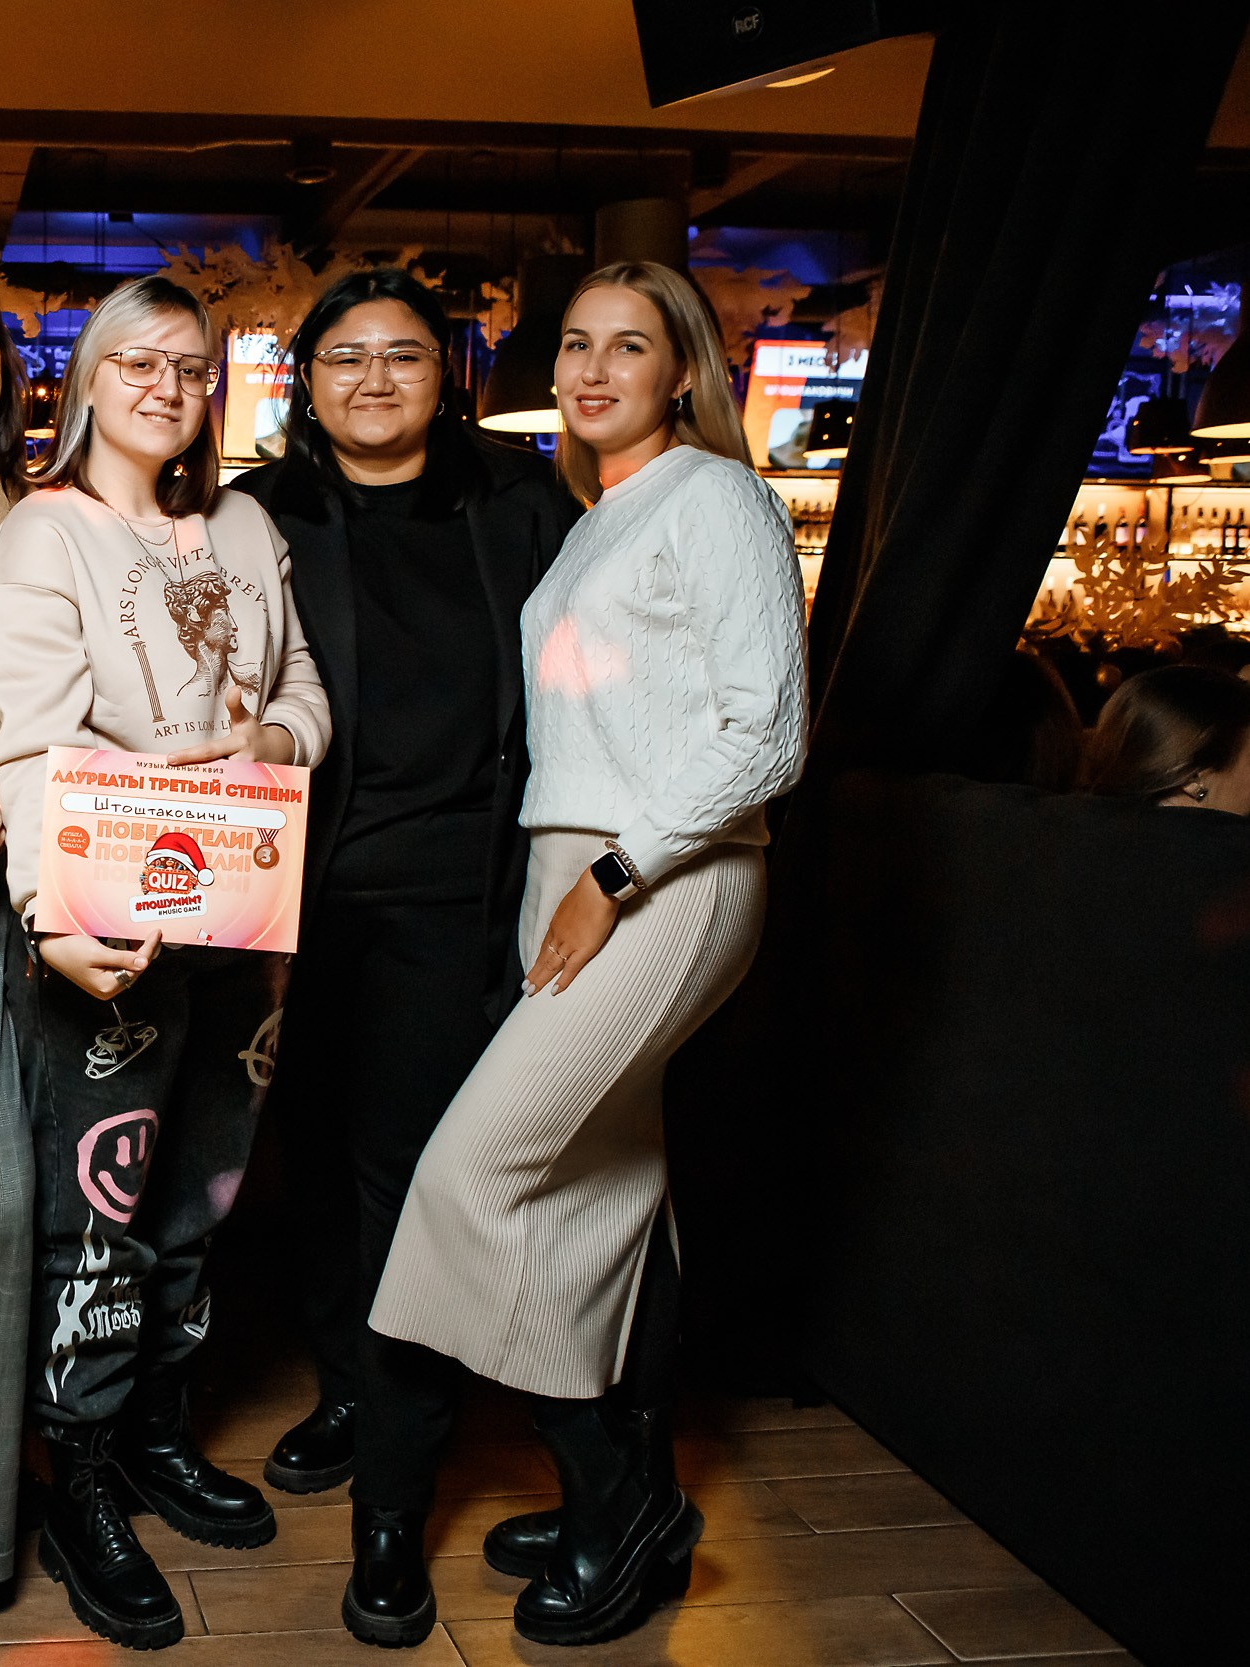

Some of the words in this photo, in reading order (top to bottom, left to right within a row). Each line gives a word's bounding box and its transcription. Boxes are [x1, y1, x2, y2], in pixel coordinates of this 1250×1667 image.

[166, 547, 217, 569] VITA
[121, 555, 167, 595] LONGA
[219, 566, 268, 613] BREV
[119, 600, 140, 639] ARS
[154, 723, 180, 738] ART
[185, 721, 196, 732] IS
[136, 761, 200, 773] МУЗЫКАЛЬНЫЙ
[51, 769, 145, 790] ЛАУРЕАТЫ
[149, 777, 221, 796] ТРЕТЬЕЙ
[225, 783, 303, 803] СТЕПЕНИ
[94, 796, 227, 822] Штоштаковичи
[260, 847, 271, 863] 3
[148, 872, 189, 891] QUIZ
[135, 895, 202, 911] #ПОШУМИМ?
[158, 908, 183, 916] #MUSIC
